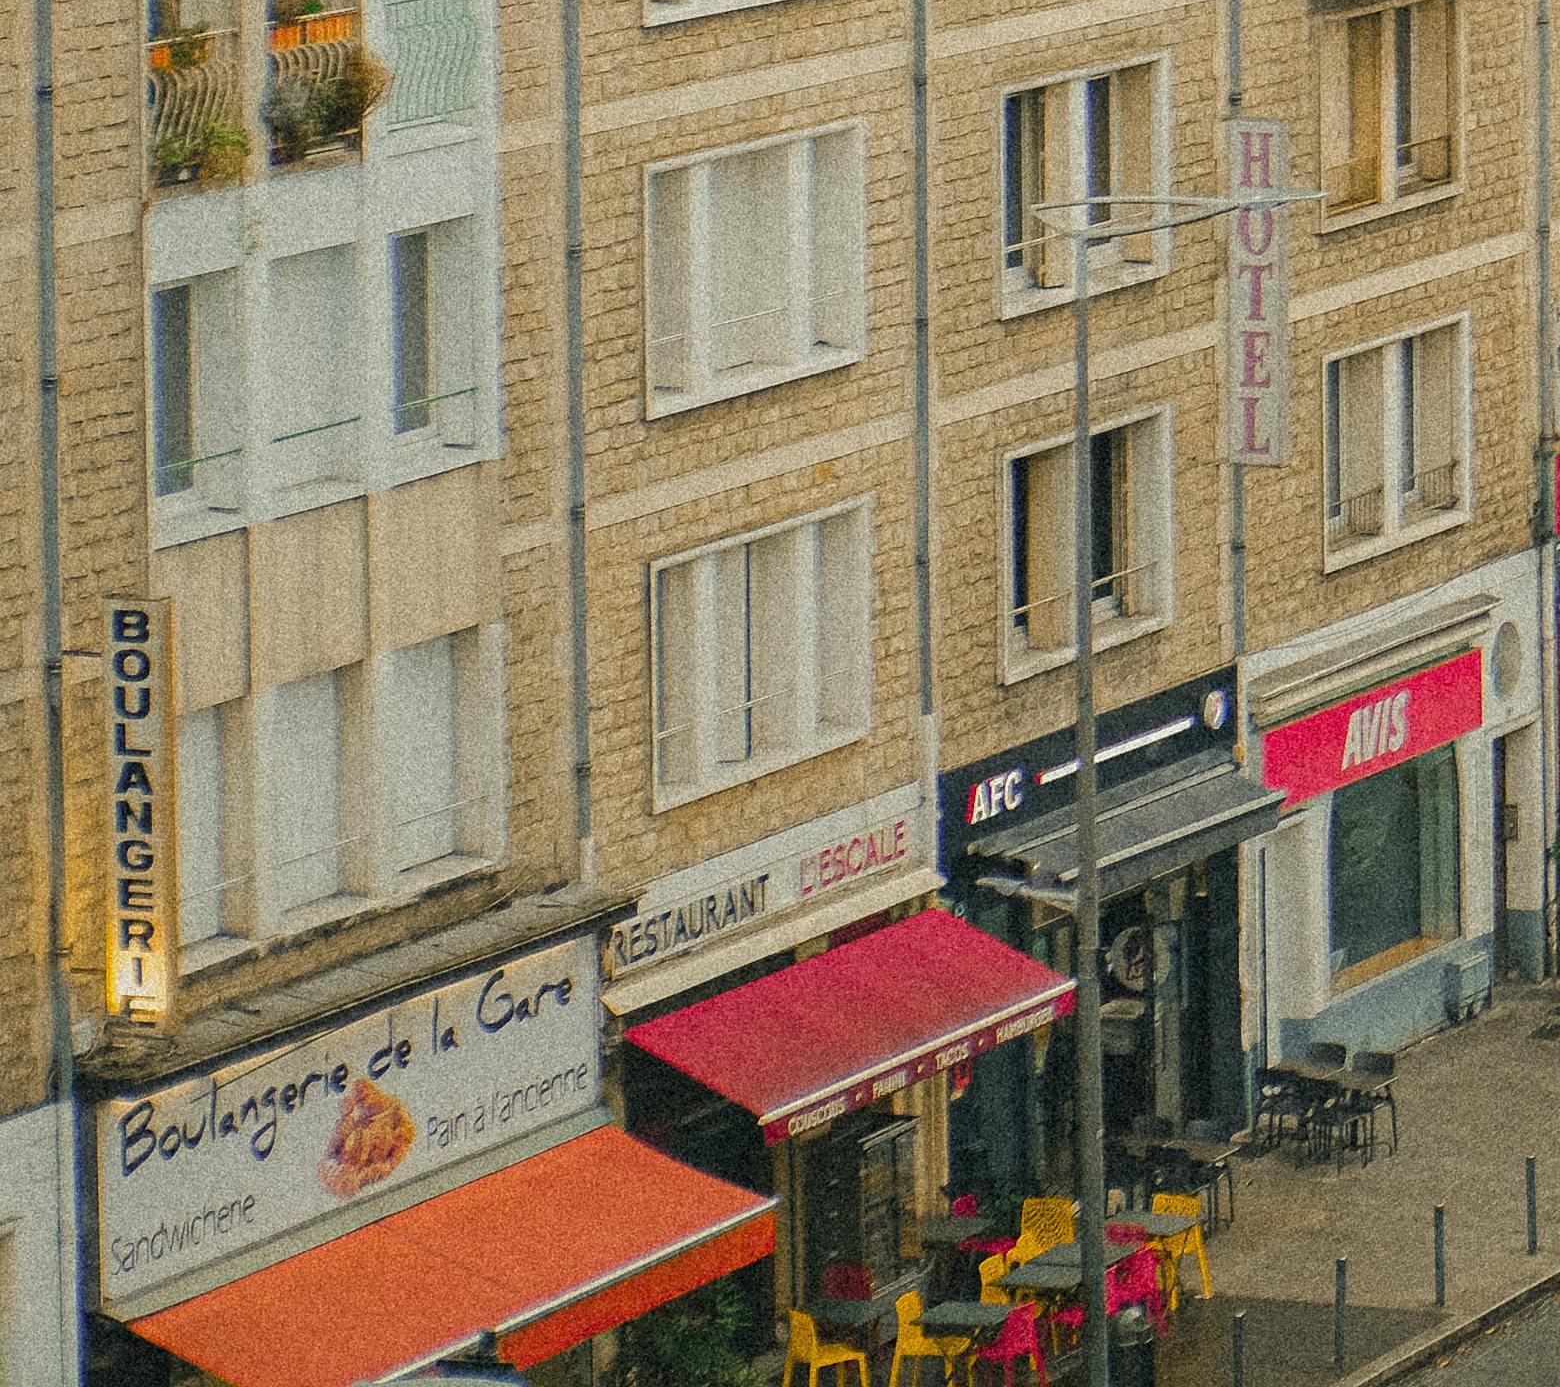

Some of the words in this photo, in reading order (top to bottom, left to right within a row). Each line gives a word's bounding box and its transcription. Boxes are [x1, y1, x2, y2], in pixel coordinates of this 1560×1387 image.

[1236, 130, 1274, 455] HOTEL
[1340, 691, 1412, 774] AVIS
[111, 608, 156, 1028] BOULANGERIE
[967, 767, 1026, 825] AFC
[611, 873, 770, 968] RESTAURANT
[117, 1055, 350, 1177] Boulangerie
[366, 1014, 414, 1082] de
[431, 997, 460, 1056] la
[475, 969, 574, 1035] Gare
[788, 1096, 847, 1138] COUSCOUS
[426, 1112, 469, 1152] Pain
